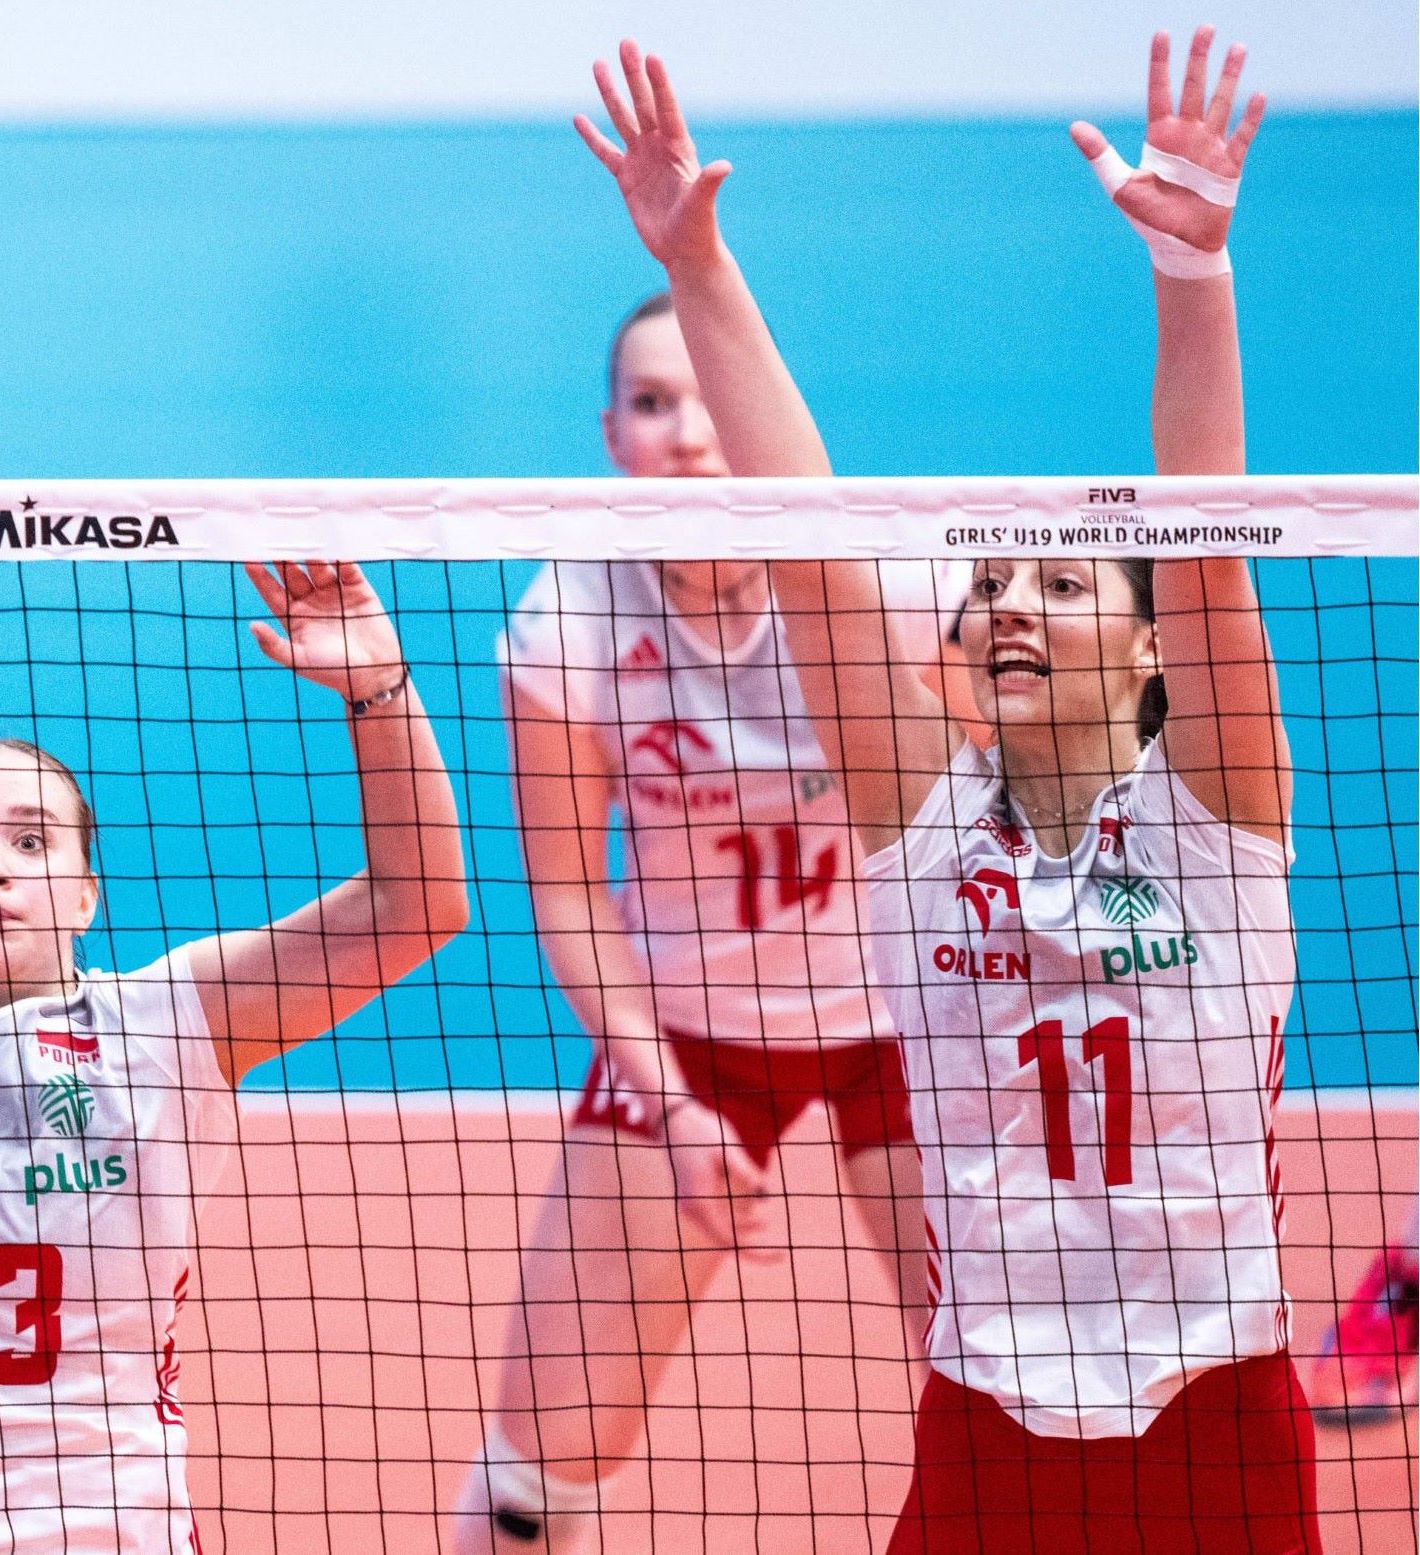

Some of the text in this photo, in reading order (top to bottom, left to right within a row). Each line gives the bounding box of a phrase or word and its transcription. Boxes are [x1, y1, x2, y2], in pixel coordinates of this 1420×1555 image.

[1088, 488, 1136, 503] FIVB
[1014, 529, 1051, 545] U19
[1059, 528, 1127, 545] WORLD
[1134, 526, 1283, 545] CHAMPIONSHIP
[1081, 514, 1146, 524] VOLLEYBALL
[715, 823, 838, 930] 14
[933, 943, 1031, 980] ORLEN
[1100, 931, 1199, 984] plus
[1017, 1016, 1133, 1187] 11
[24, 1152, 127, 1206] plus
